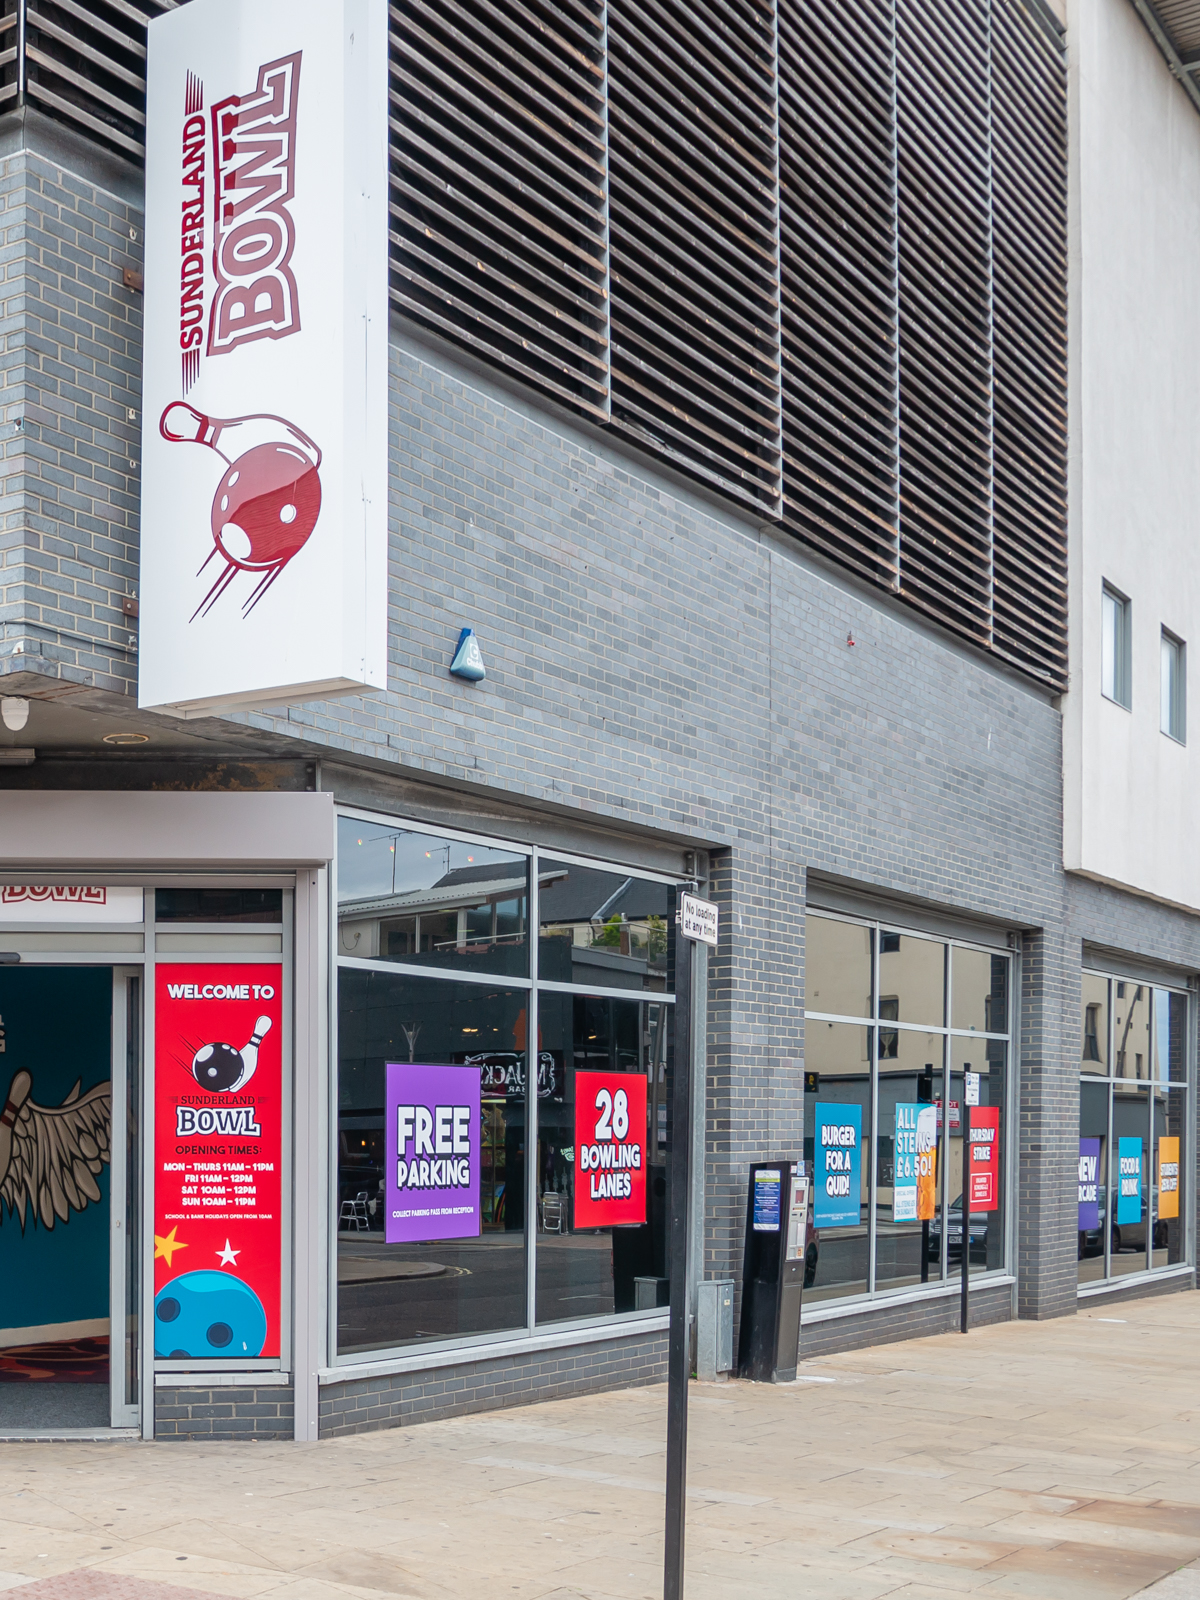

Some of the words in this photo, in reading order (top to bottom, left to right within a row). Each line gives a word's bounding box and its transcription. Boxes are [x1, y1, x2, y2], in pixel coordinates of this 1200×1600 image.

[206, 50, 303, 357] BOWL
[180, 115, 206, 349] SUNDERLAND
[686, 901, 694, 915] No
[695, 904, 716, 925] loading
[685, 918, 691, 930] at
[692, 922, 702, 936] any
[167, 984, 249, 999] WELCOME
[252, 985, 275, 1000] TO
[181, 1095, 255, 1105] SUNDERLAND
[176, 1105, 261, 1137] BOWL
[594, 1087, 630, 1143] 28
[897, 1107, 915, 1130] ALL
[397, 1104, 471, 1158] FREE
[821, 1124, 856, 1148] BURGER
[175, 1145, 226, 1154] OPENING
[228, 1145, 262, 1154] TIMES:
[897, 1132, 931, 1154] STEINS
[973, 1145, 991, 1161] STRIKE
[164, 1163, 185, 1171] MON
[193, 1163, 221, 1171] THURS
[222, 1163, 245, 1171] 11AM
[252, 1163, 274, 1171] 11PM
[580, 1143, 641, 1172] BOWLING
[825, 1150, 843, 1172] FOR
[843, 1150, 851, 1172] A
[896, 1156, 932, 1178] £6.50!
[1120, 1156, 1135, 1174] FOOD
[185, 1174, 199, 1183] FRI
[200, 1174, 222, 1183] 11AM
[230, 1174, 253, 1183] 12PM
[397, 1158, 471, 1190] PARKING
[181, 1186, 198, 1194] SAT
[201, 1186, 226, 1194] 10AM
[233, 1186, 256, 1194] 12PM
[590, 1172, 632, 1200] LANES
[826, 1174, 850, 1198] QUID!
[1078, 1184, 1097, 1202] RCADE
[1121, 1178, 1138, 1196] DRINK
[182, 1197, 200, 1206] SUN
[202, 1197, 226, 1206] 10AM
[234, 1197, 256, 1206] 11PM
[392, 1209, 411, 1218] COLLECT
[411, 1208, 429, 1217] PARKING
[441, 1207, 452, 1215] FROM
[453, 1206, 474, 1214] RECEPTION
